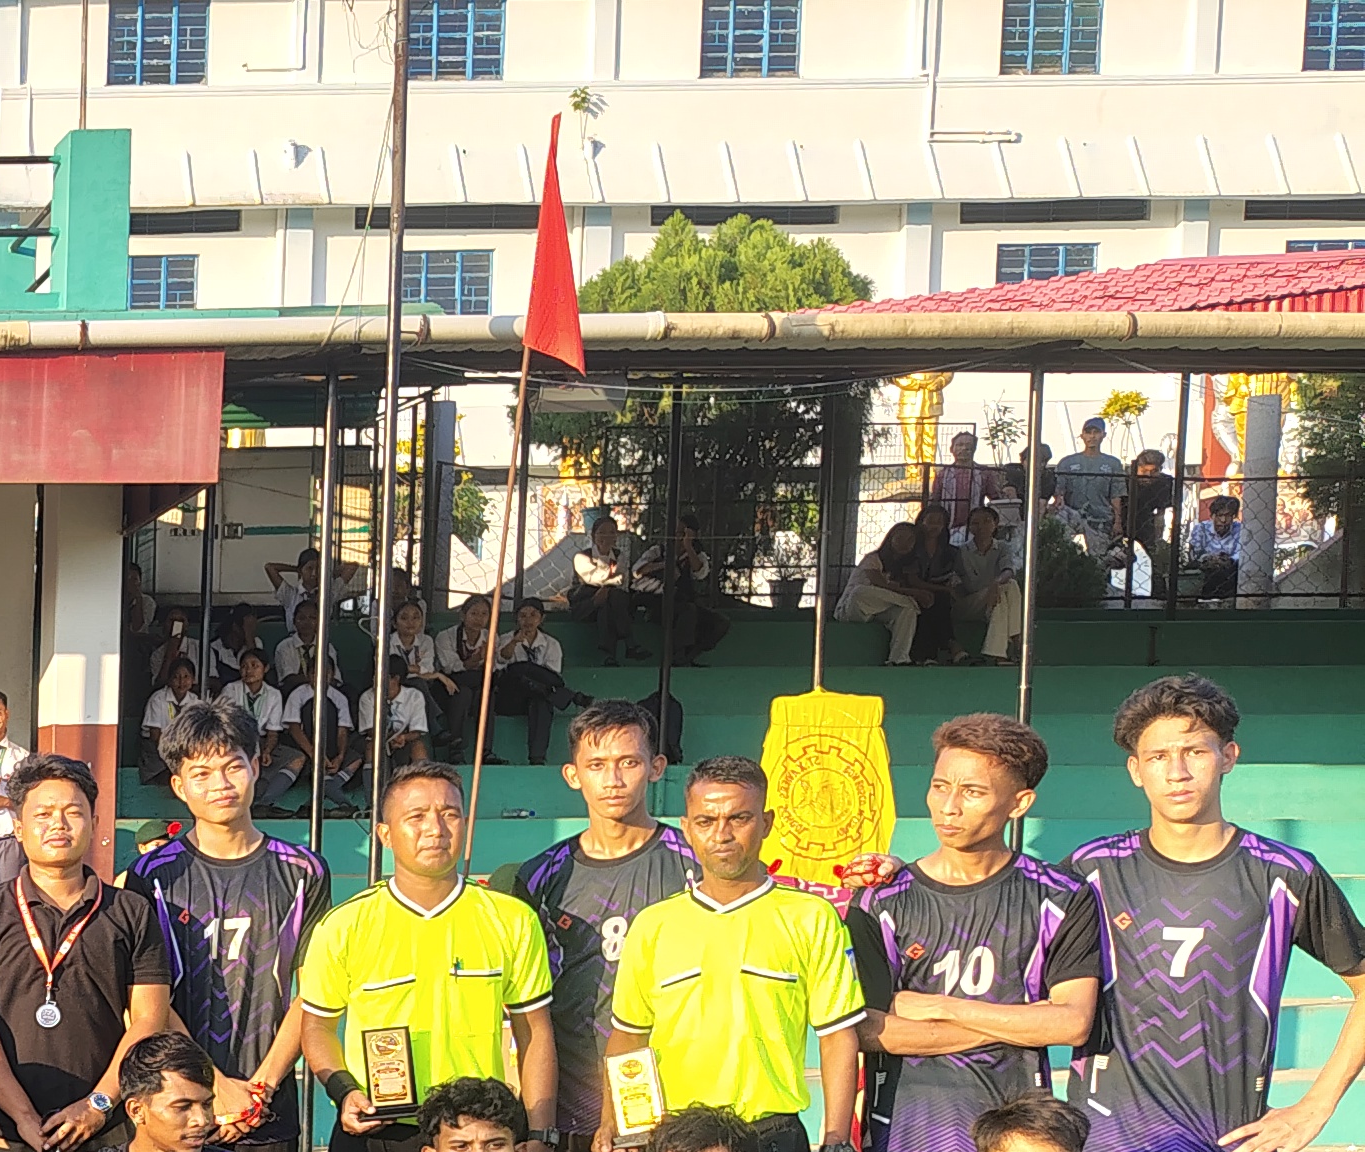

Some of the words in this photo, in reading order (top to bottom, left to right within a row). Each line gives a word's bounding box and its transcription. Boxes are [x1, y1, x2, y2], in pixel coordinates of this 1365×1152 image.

[203, 915, 252, 961] 17
[600, 916, 628, 962] 8
[1161, 926, 1205, 978] 7
[932, 946, 996, 996] 10
